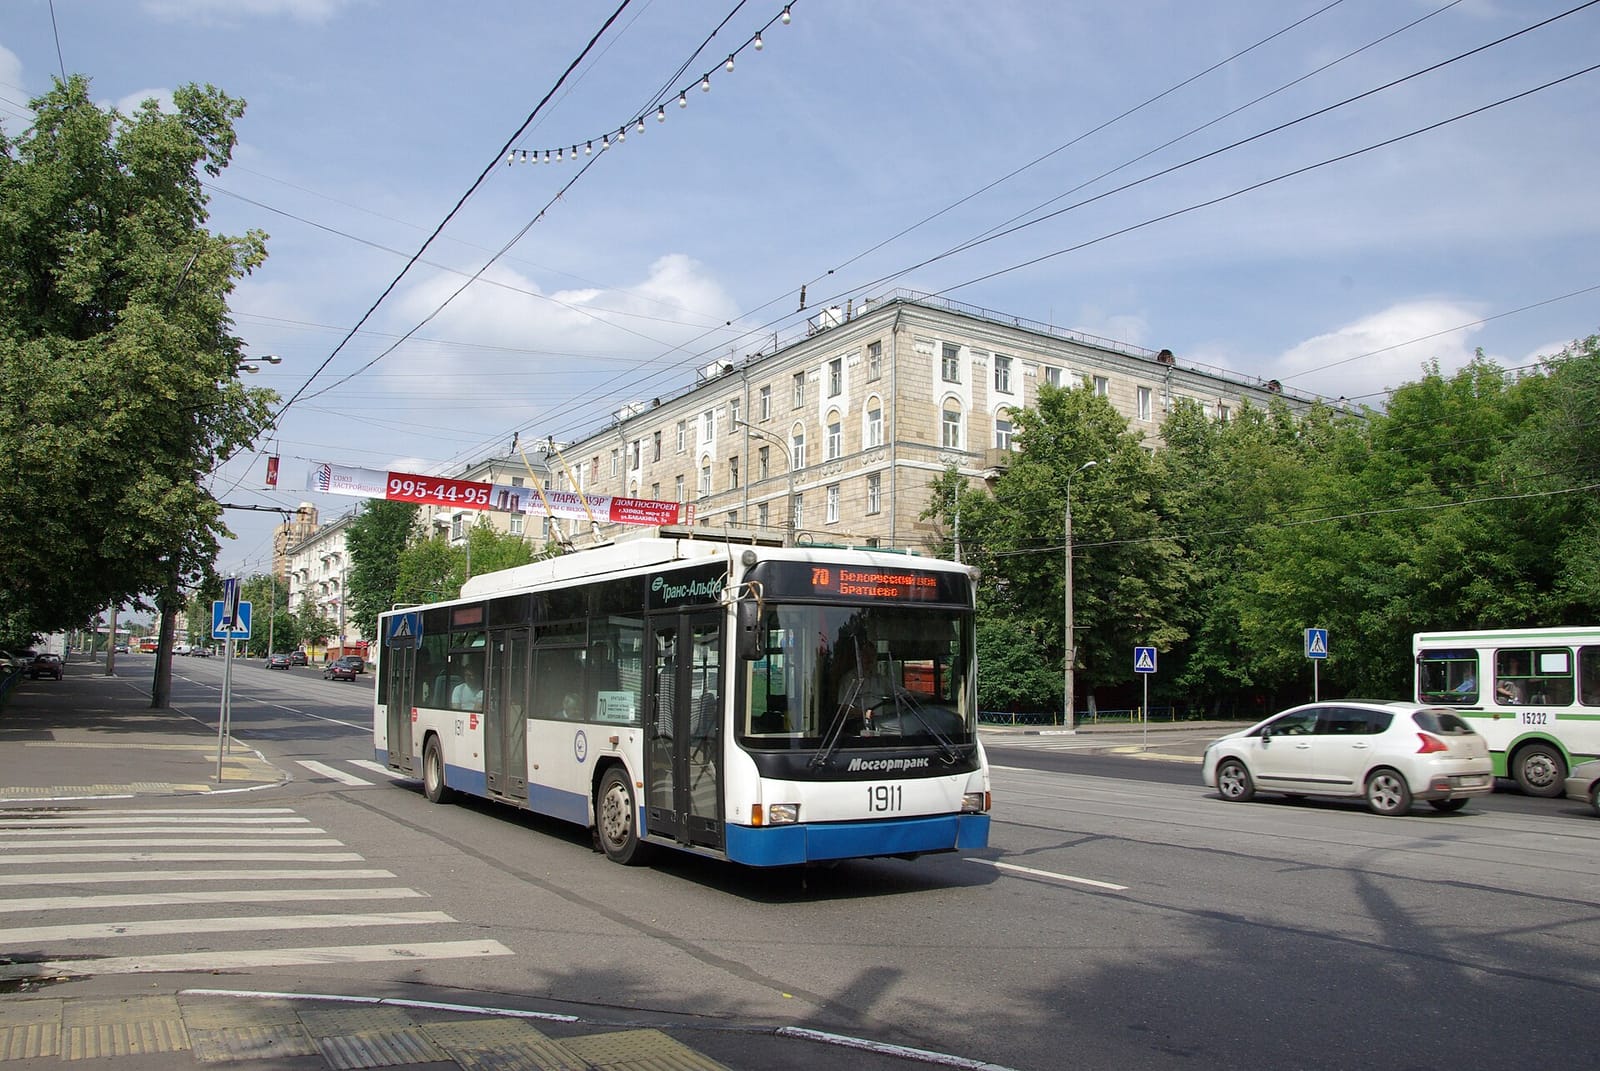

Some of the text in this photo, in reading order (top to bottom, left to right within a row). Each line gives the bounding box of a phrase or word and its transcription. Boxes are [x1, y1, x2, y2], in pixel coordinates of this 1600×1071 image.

[389, 478, 488, 505] 995-44-95
[614, 499, 677, 511] ДОМ ПОСТРОЕН
[811, 568, 829, 585] 70
[839, 570, 916, 585] Белорусский
[662, 577, 722, 604] Транс-Альфа
[839, 583, 898, 597] Братцево
[599, 698, 607, 716] 70
[1522, 712, 1548, 725] 15232
[847, 758, 930, 772] Мосгортранс
[867, 785, 902, 812] 1911
